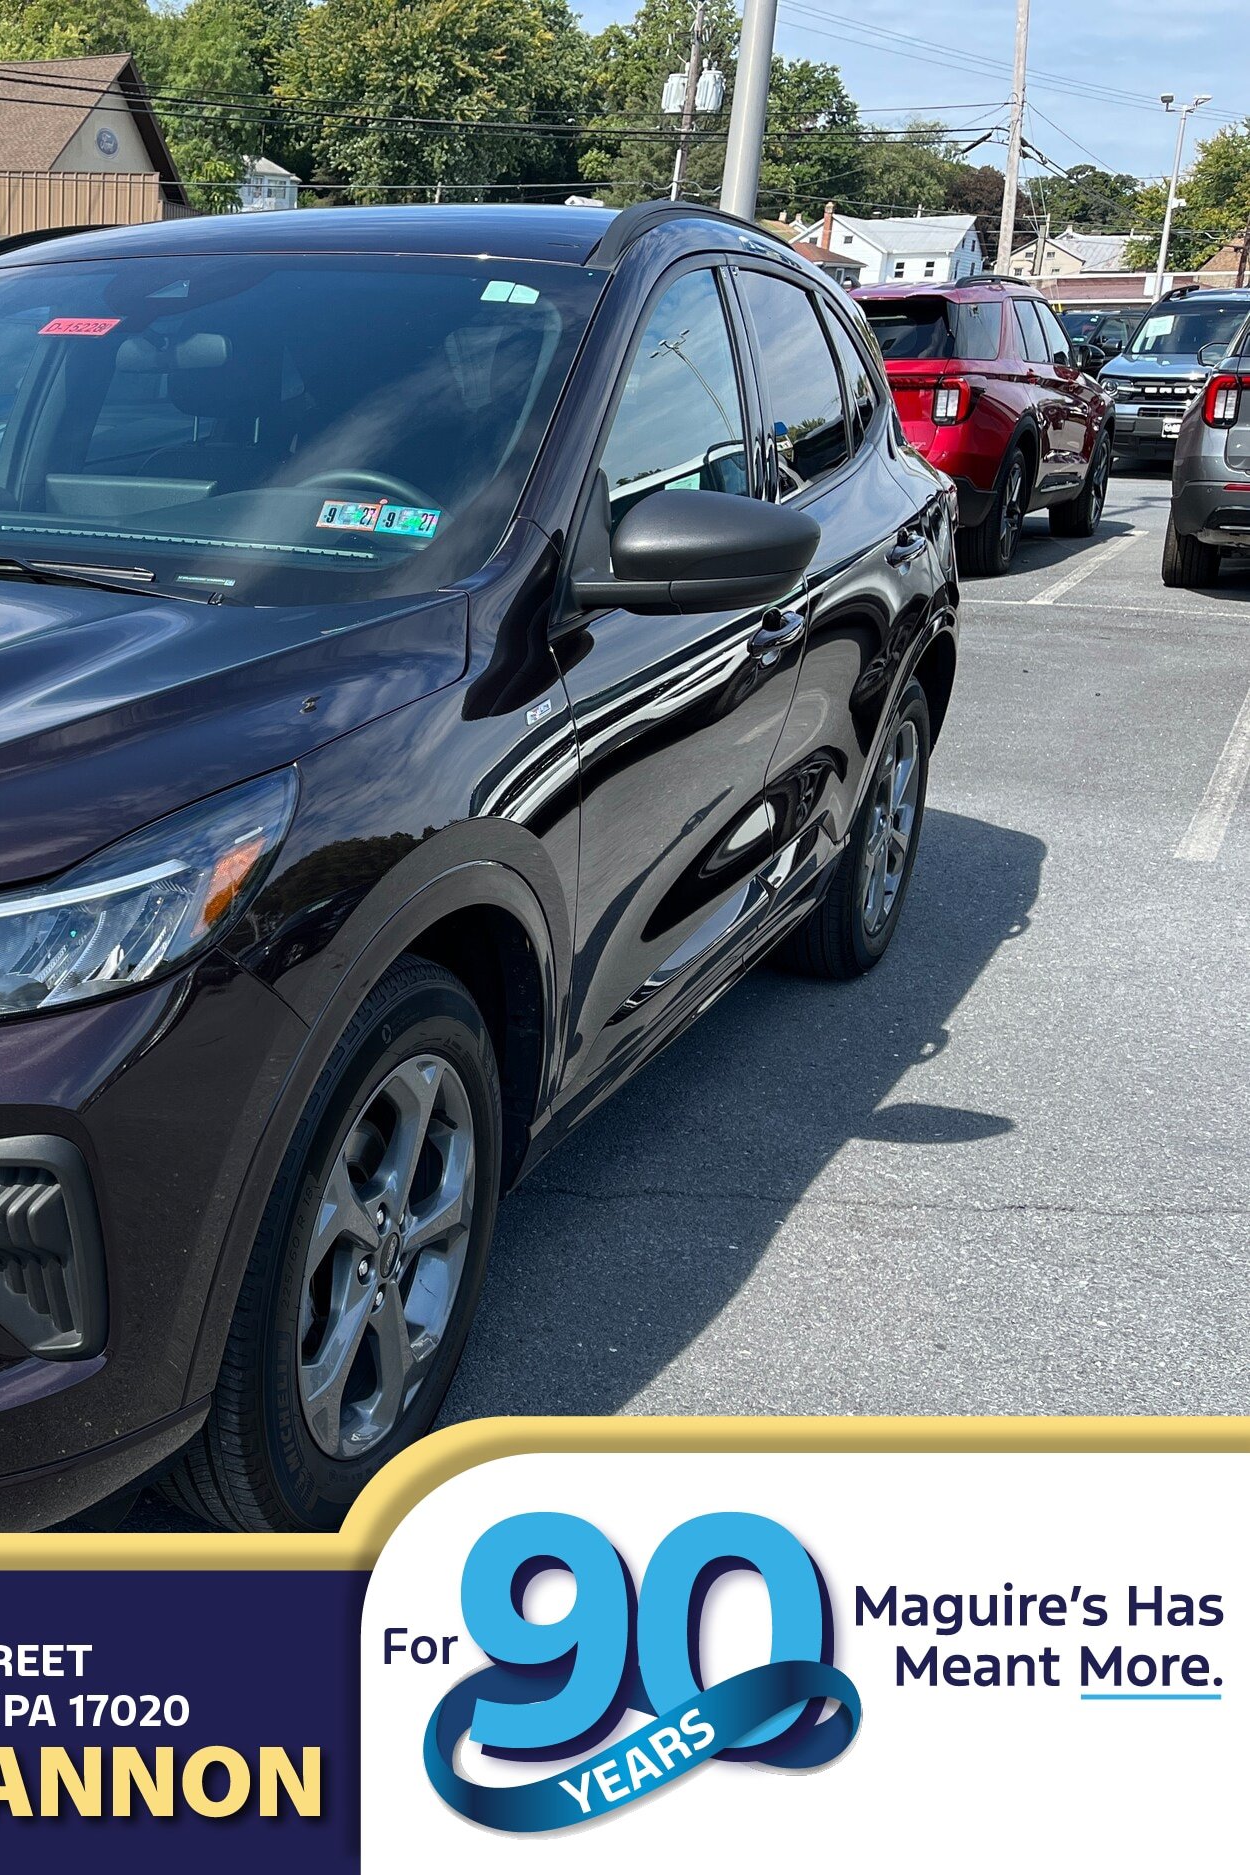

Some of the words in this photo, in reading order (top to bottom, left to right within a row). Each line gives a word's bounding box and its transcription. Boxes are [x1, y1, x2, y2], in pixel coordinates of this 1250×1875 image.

[327, 507, 338, 524] 9
[360, 507, 377, 526] 27
[385, 511, 396, 528] 9
[418, 512, 436, 532] 27
[276, 1337, 302, 1475] MICHELIN
